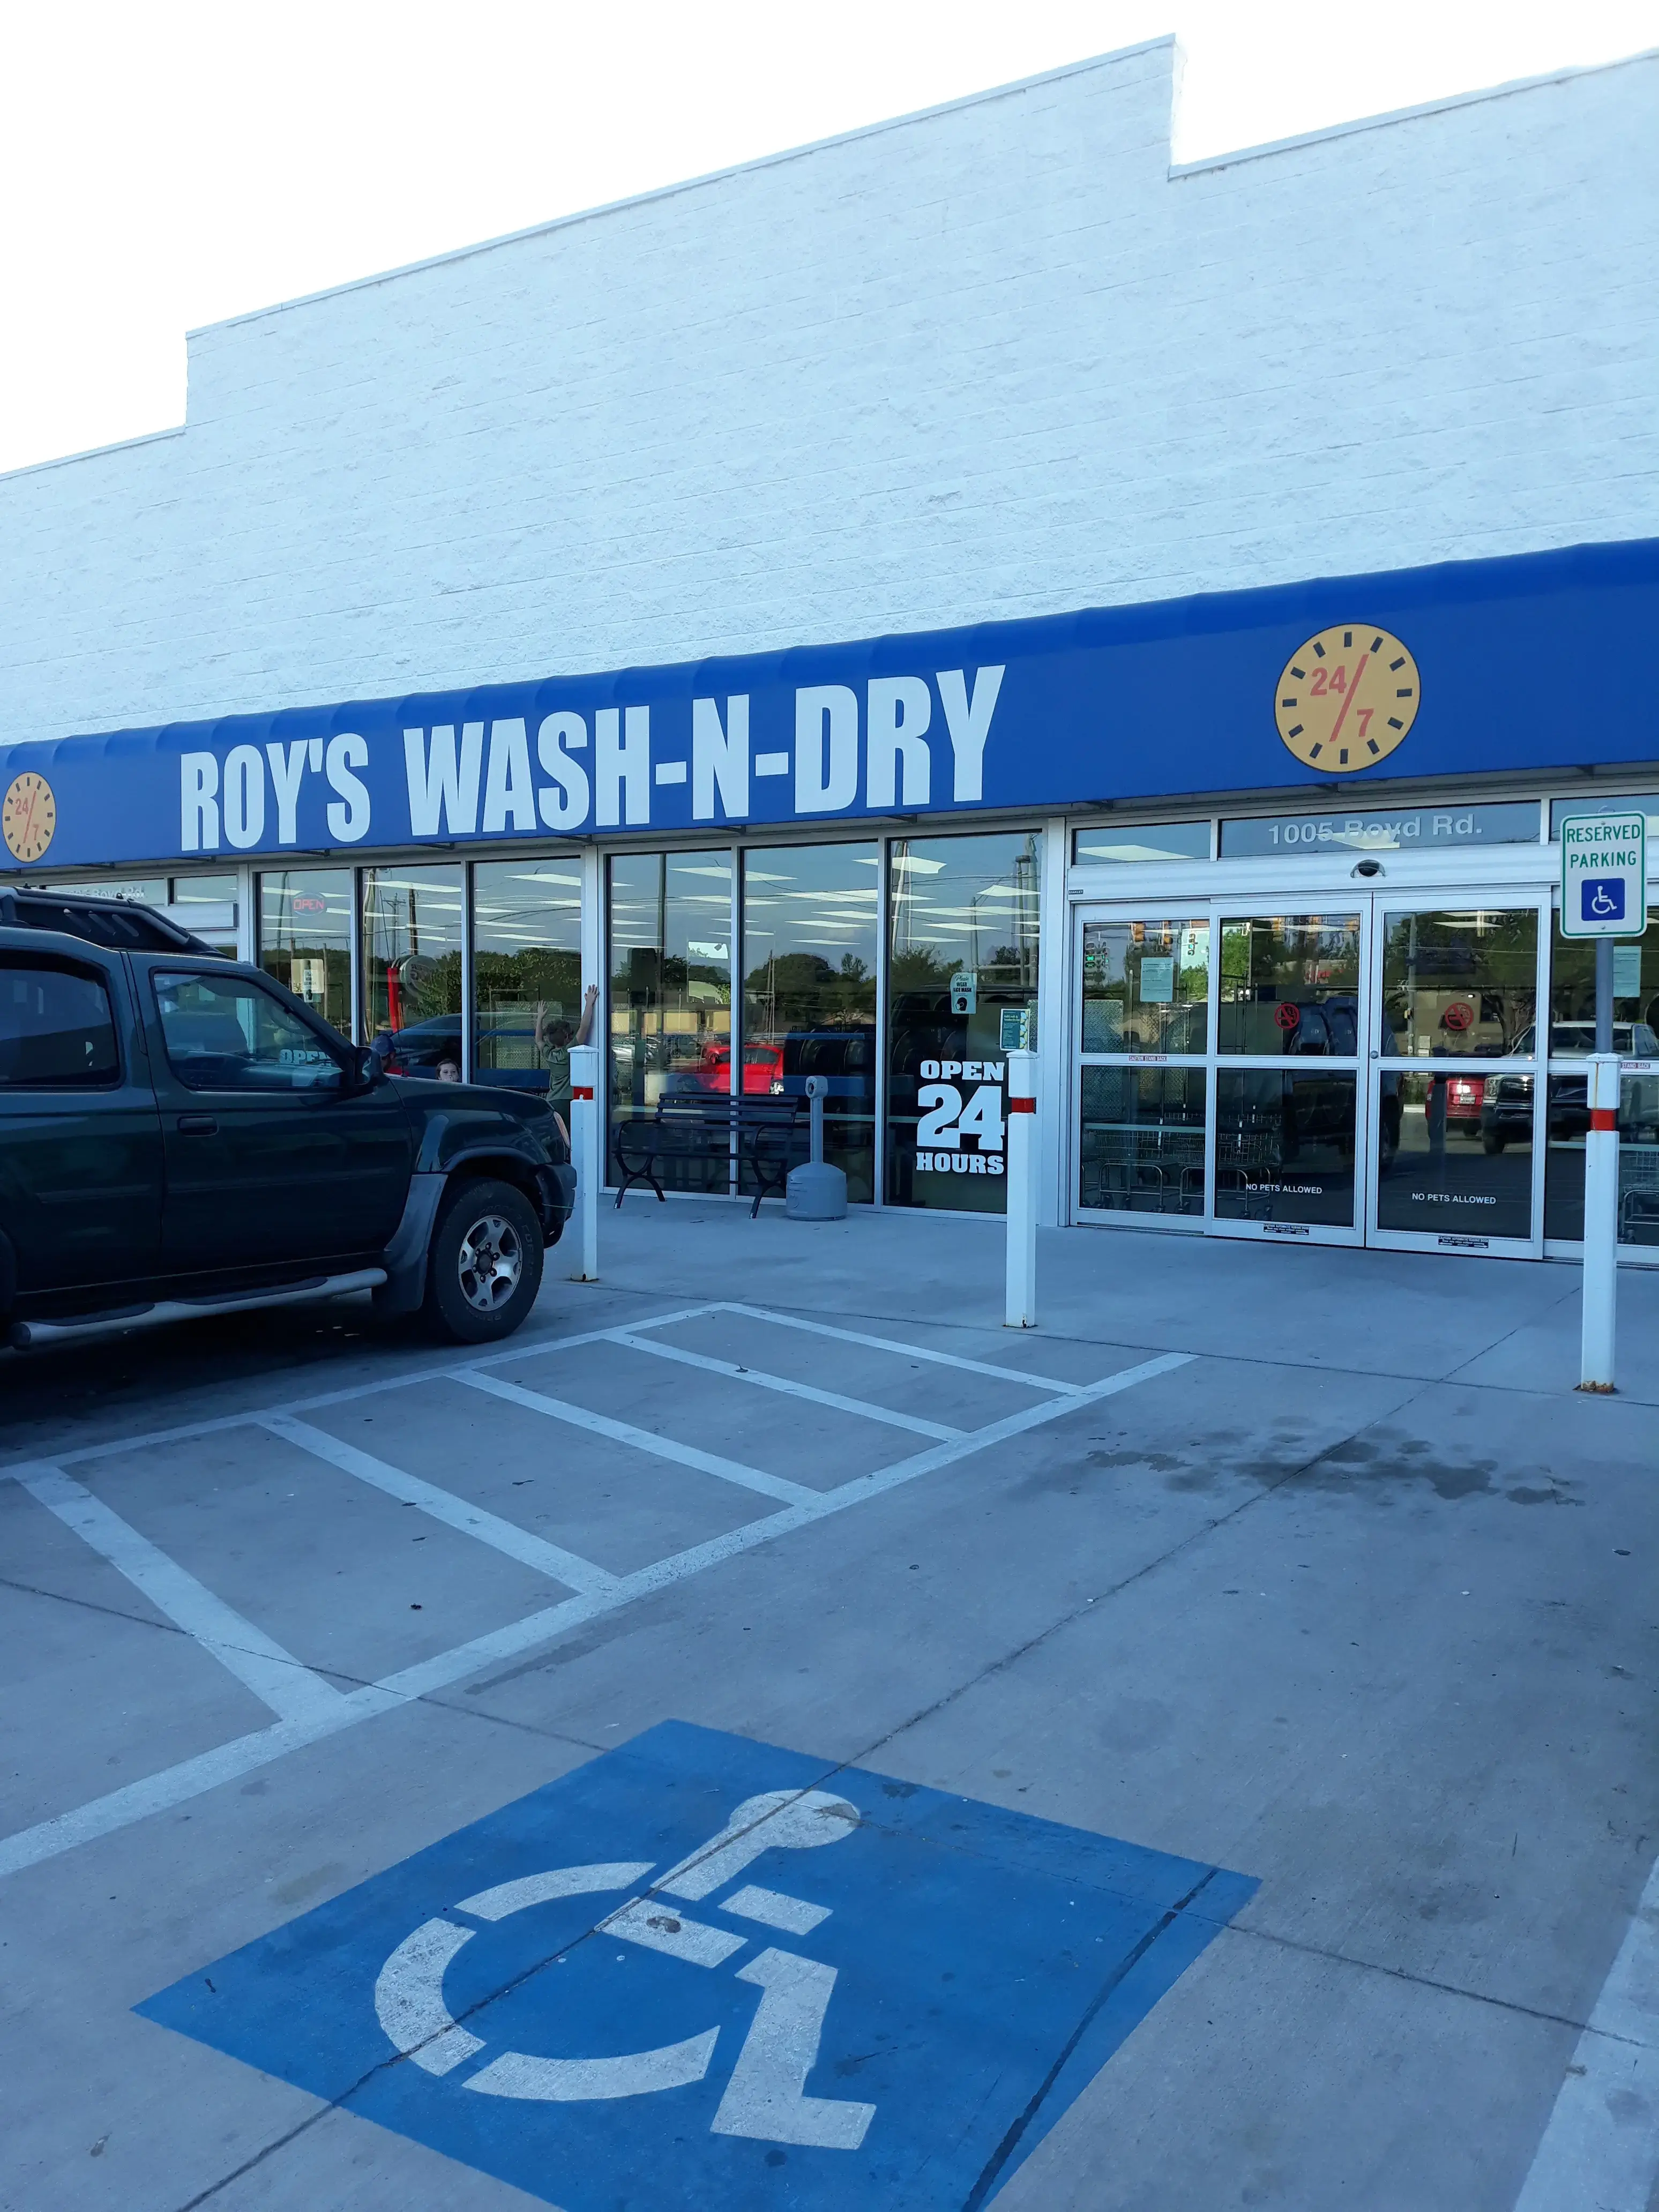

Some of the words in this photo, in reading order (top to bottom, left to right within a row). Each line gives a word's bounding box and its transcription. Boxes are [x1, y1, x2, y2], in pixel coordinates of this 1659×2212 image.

[181, 733, 371, 851] ROY'S
[403, 664, 1006, 836] WASH-N-DRY
[1268, 821, 1334, 845] 1005
[1344, 816, 1422, 842] Boyd
[1432, 814, 1483, 835] Rd.
[1567, 824, 1641, 843] RESERVED
[1570, 851, 1636, 869] PARKING
[293, 899, 324, 909] OPEN
[920, 1060, 1005, 1081] OPEN
[917, 1083, 1005, 1150] 24
[916, 1152, 1004, 1175] HOURS
[1260, 1184, 1280, 1192] PETS
[1282, 1185, 1322, 1194] ALLOWED
[1428, 1193, 1450, 1202] PETS
[1452, 1195, 1497, 1204] ALLOWED
